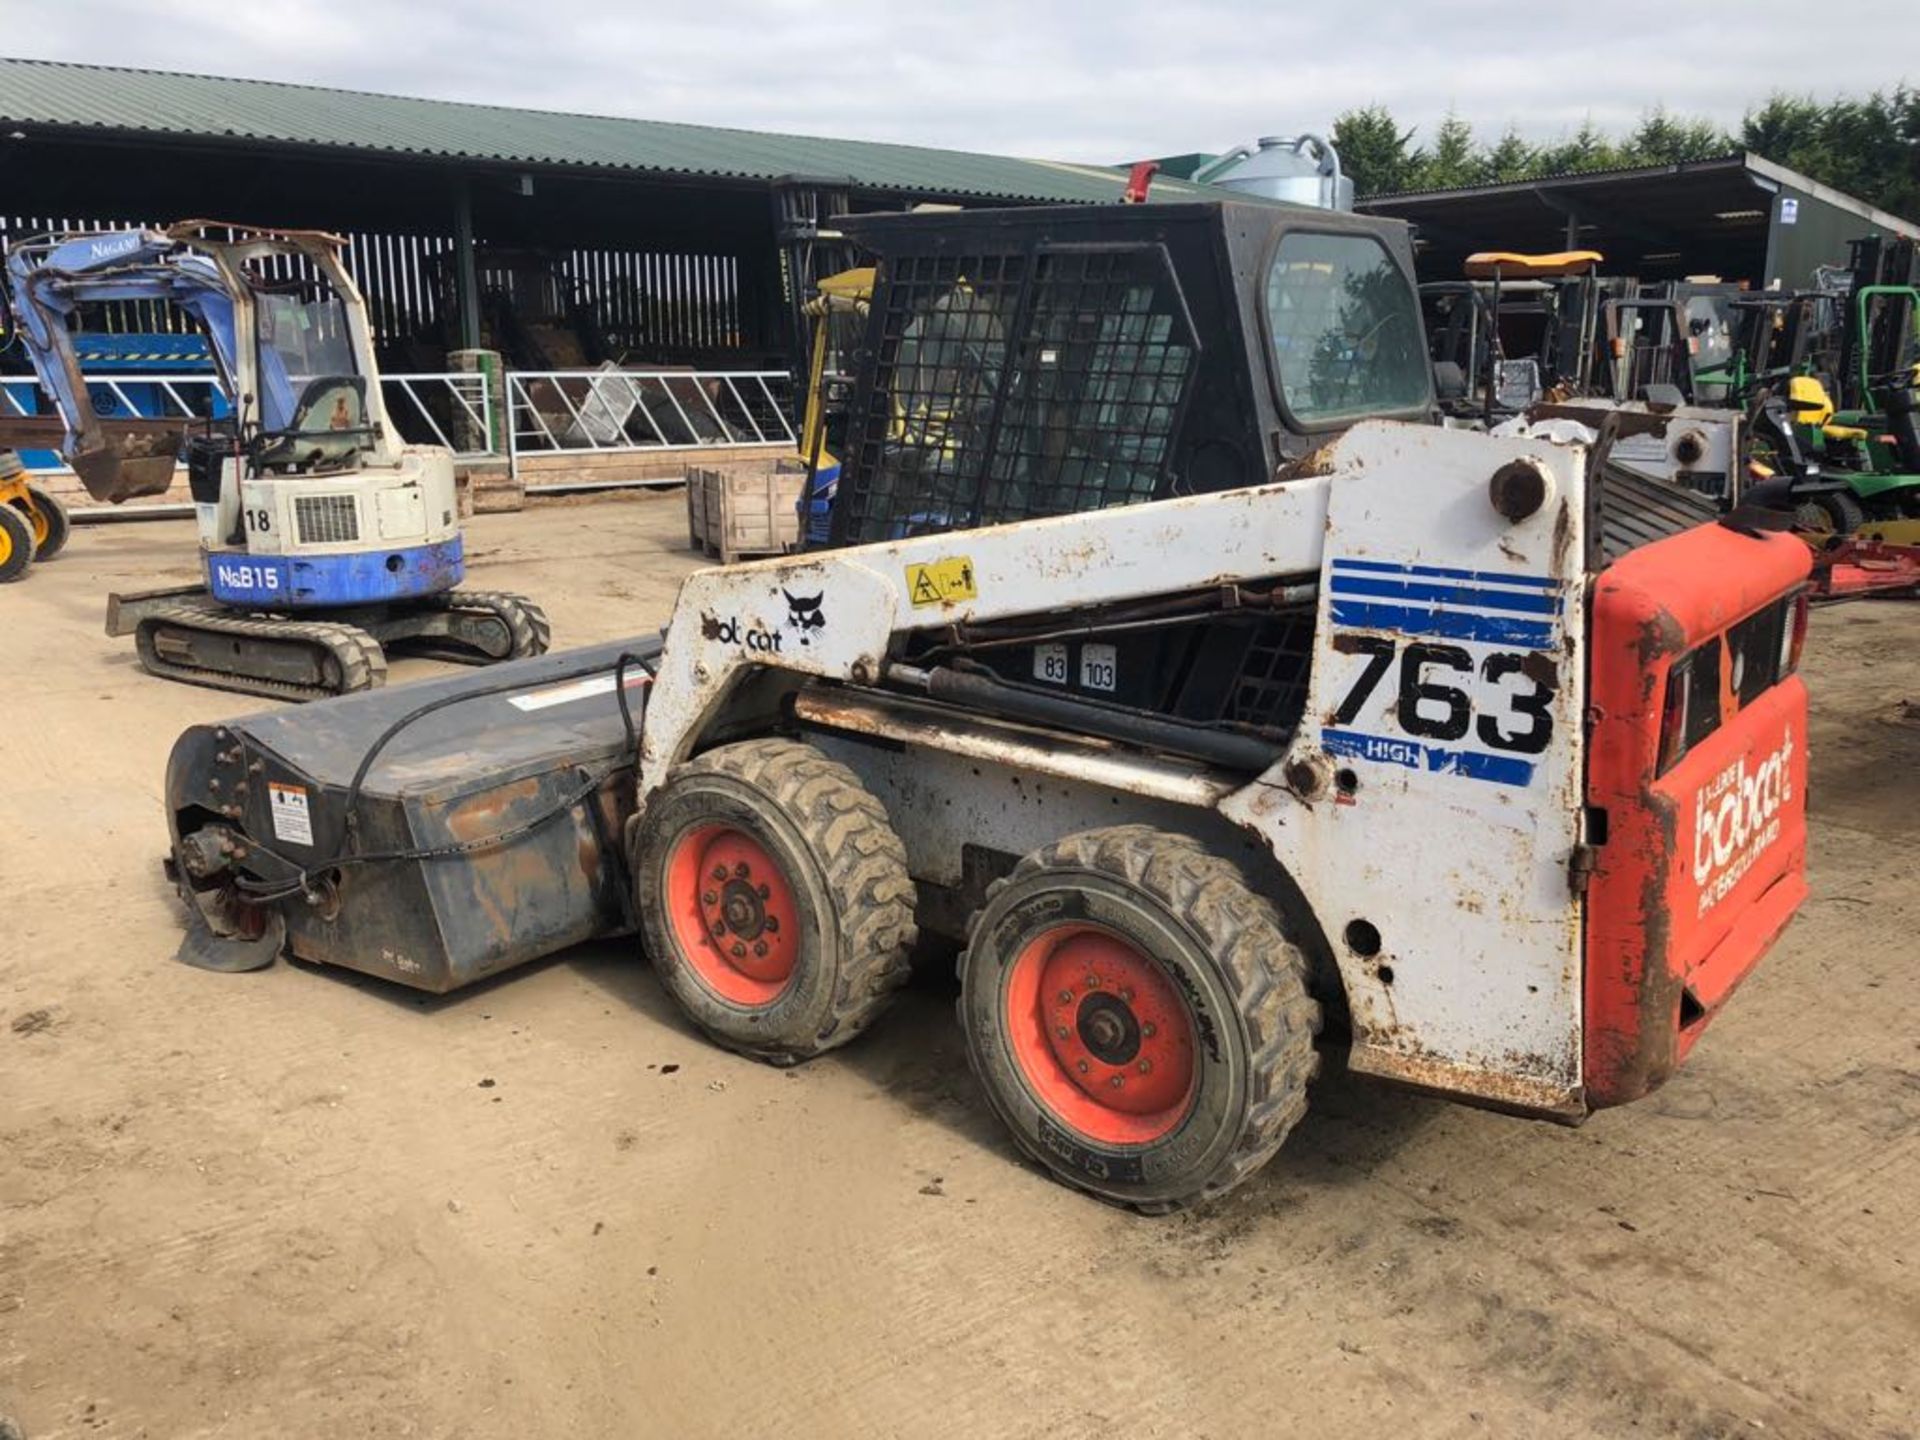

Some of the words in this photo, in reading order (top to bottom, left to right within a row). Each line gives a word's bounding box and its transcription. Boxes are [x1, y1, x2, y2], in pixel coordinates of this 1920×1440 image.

[246, 509, 270, 532] 18
[1046, 656, 1065, 680] 83
[1085, 663, 1113, 688] 103
[1333, 634, 1558, 754] 763
